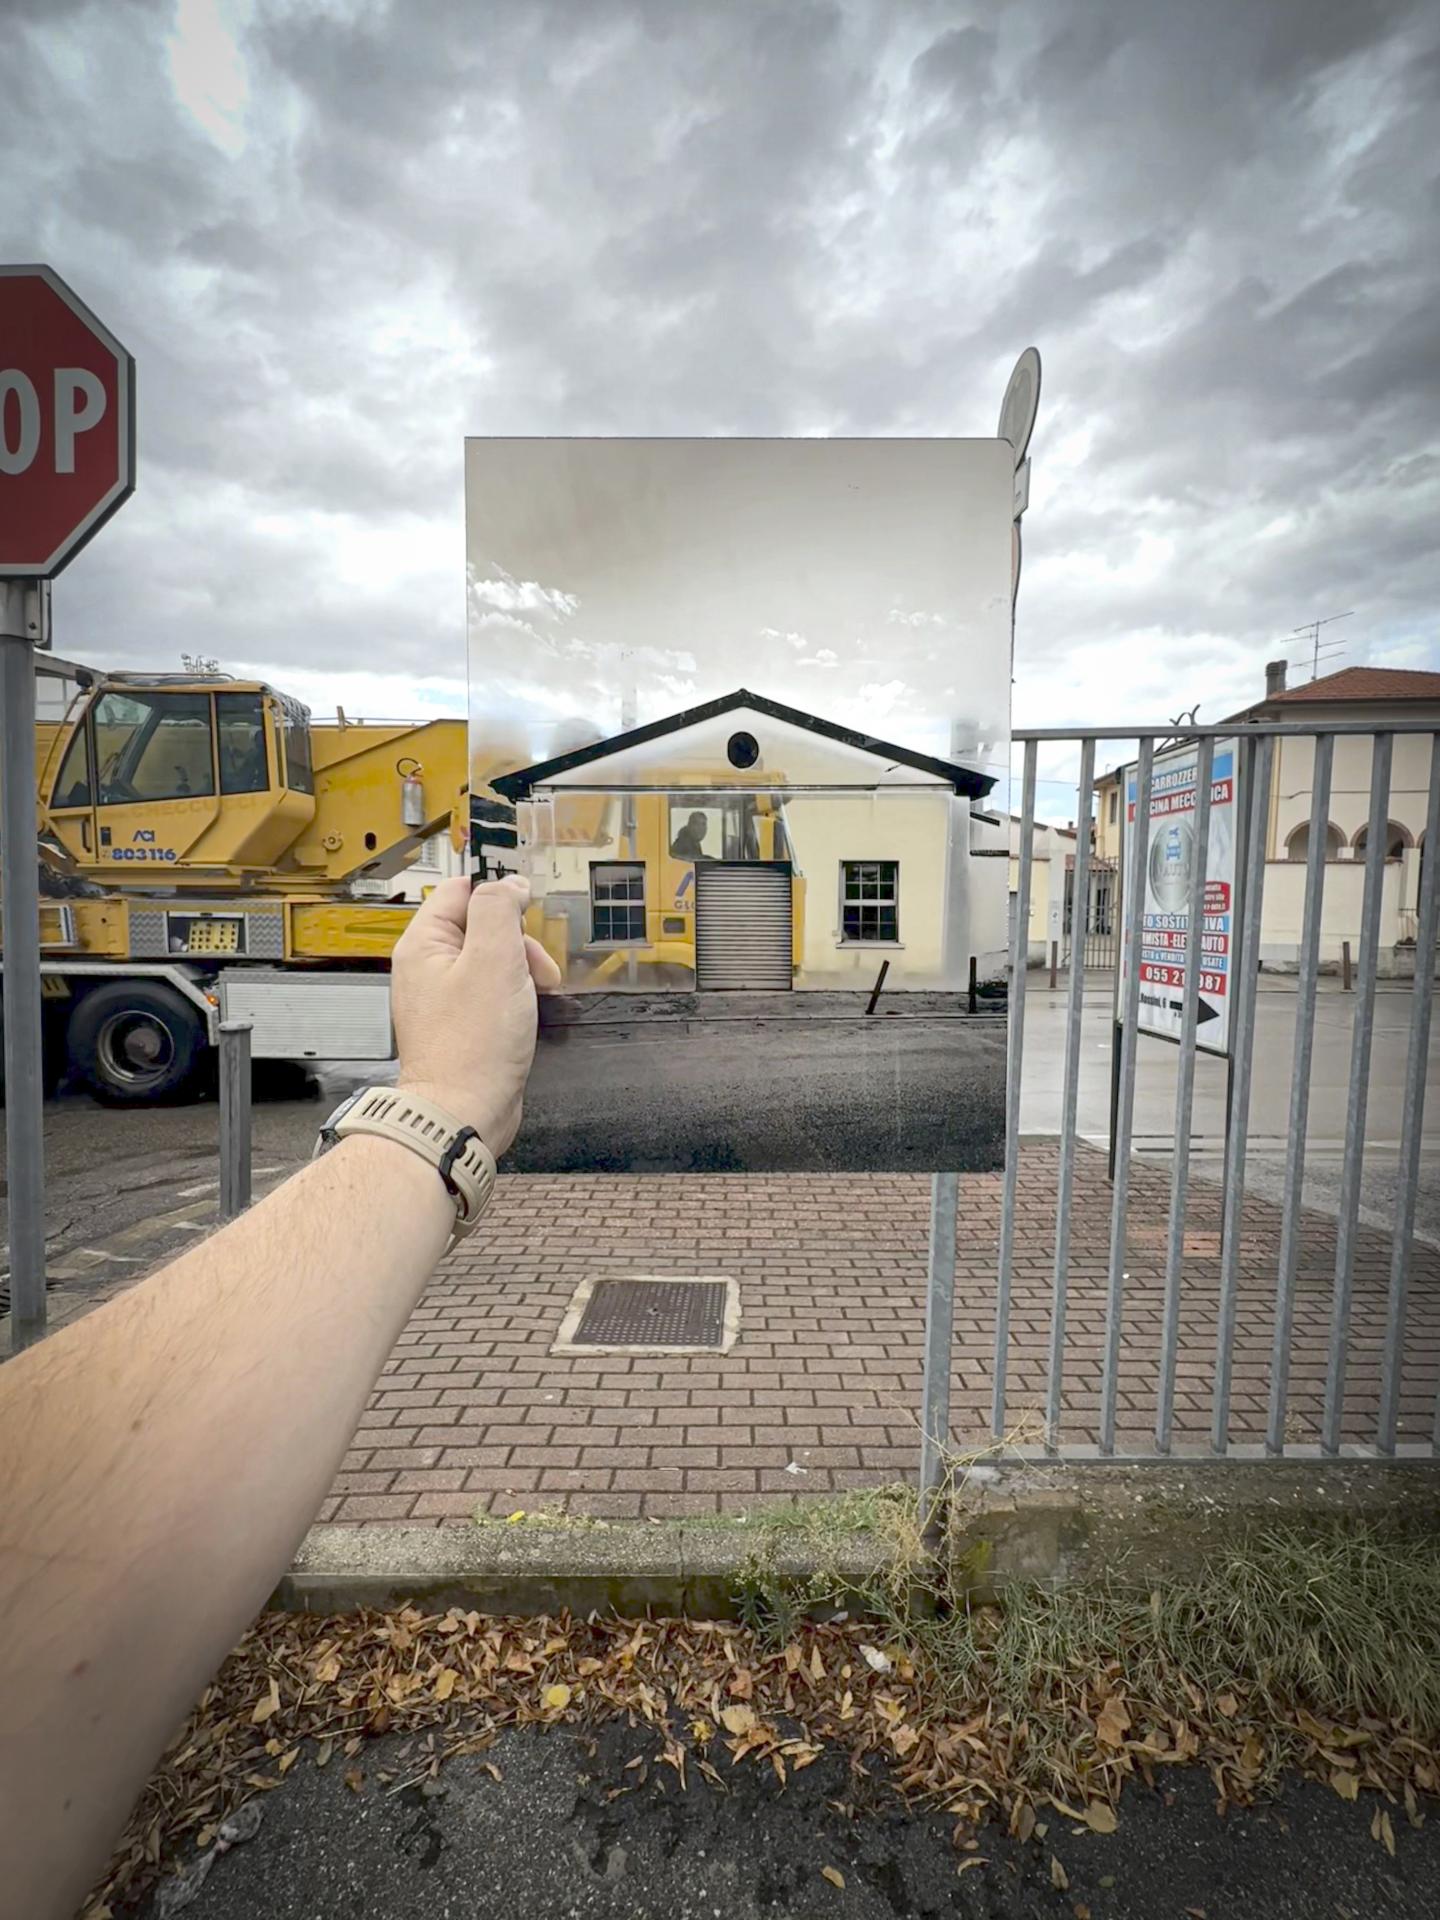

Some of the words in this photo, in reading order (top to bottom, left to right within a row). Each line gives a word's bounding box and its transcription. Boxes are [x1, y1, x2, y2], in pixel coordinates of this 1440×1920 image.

[0, 367, 107, 476] OP
[1151, 766, 1198, 792] CARROZZER
[1171, 783, 1229, 811] MECCICA
[111, 848, 177, 861] 803116
[1145, 966, 1168, 982] 055
